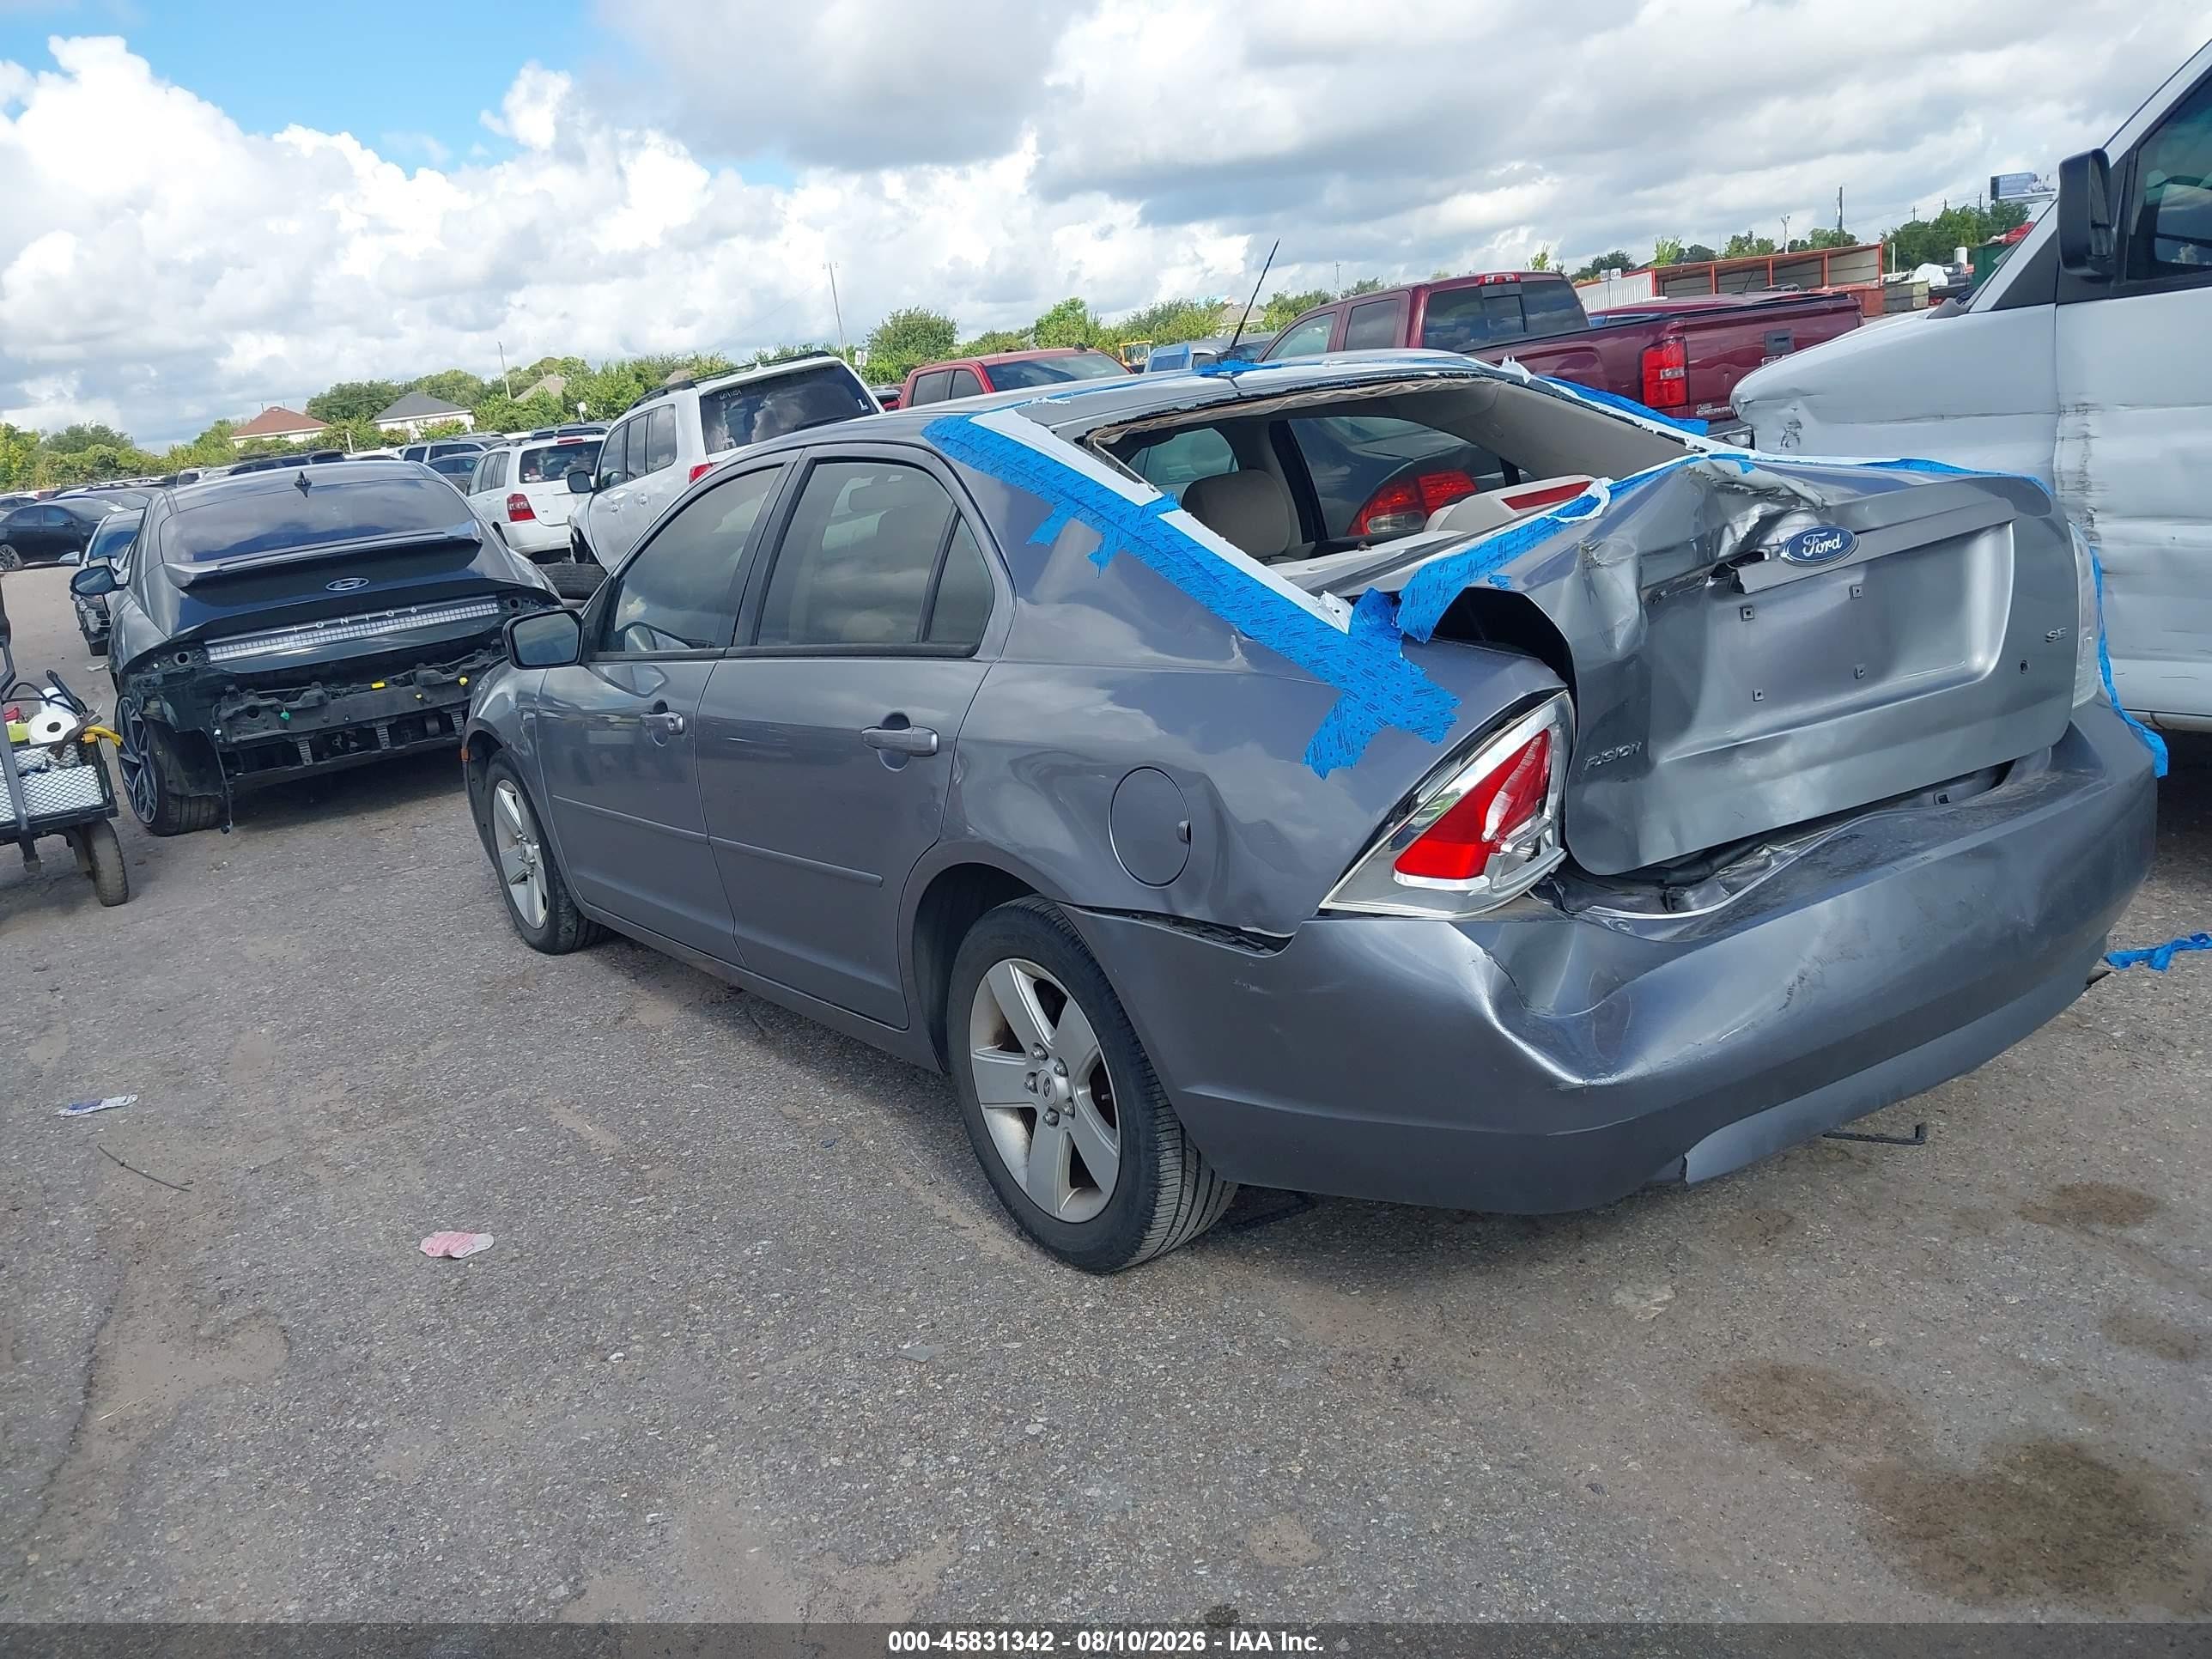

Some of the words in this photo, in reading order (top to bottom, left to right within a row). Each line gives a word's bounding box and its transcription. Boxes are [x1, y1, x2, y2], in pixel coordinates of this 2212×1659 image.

[1802, 532, 1843, 557] Ford
[293, 610, 395, 633] IONIQ
[2045, 627, 2067, 643] SE
[1583, 742, 1642, 770] FUSION
